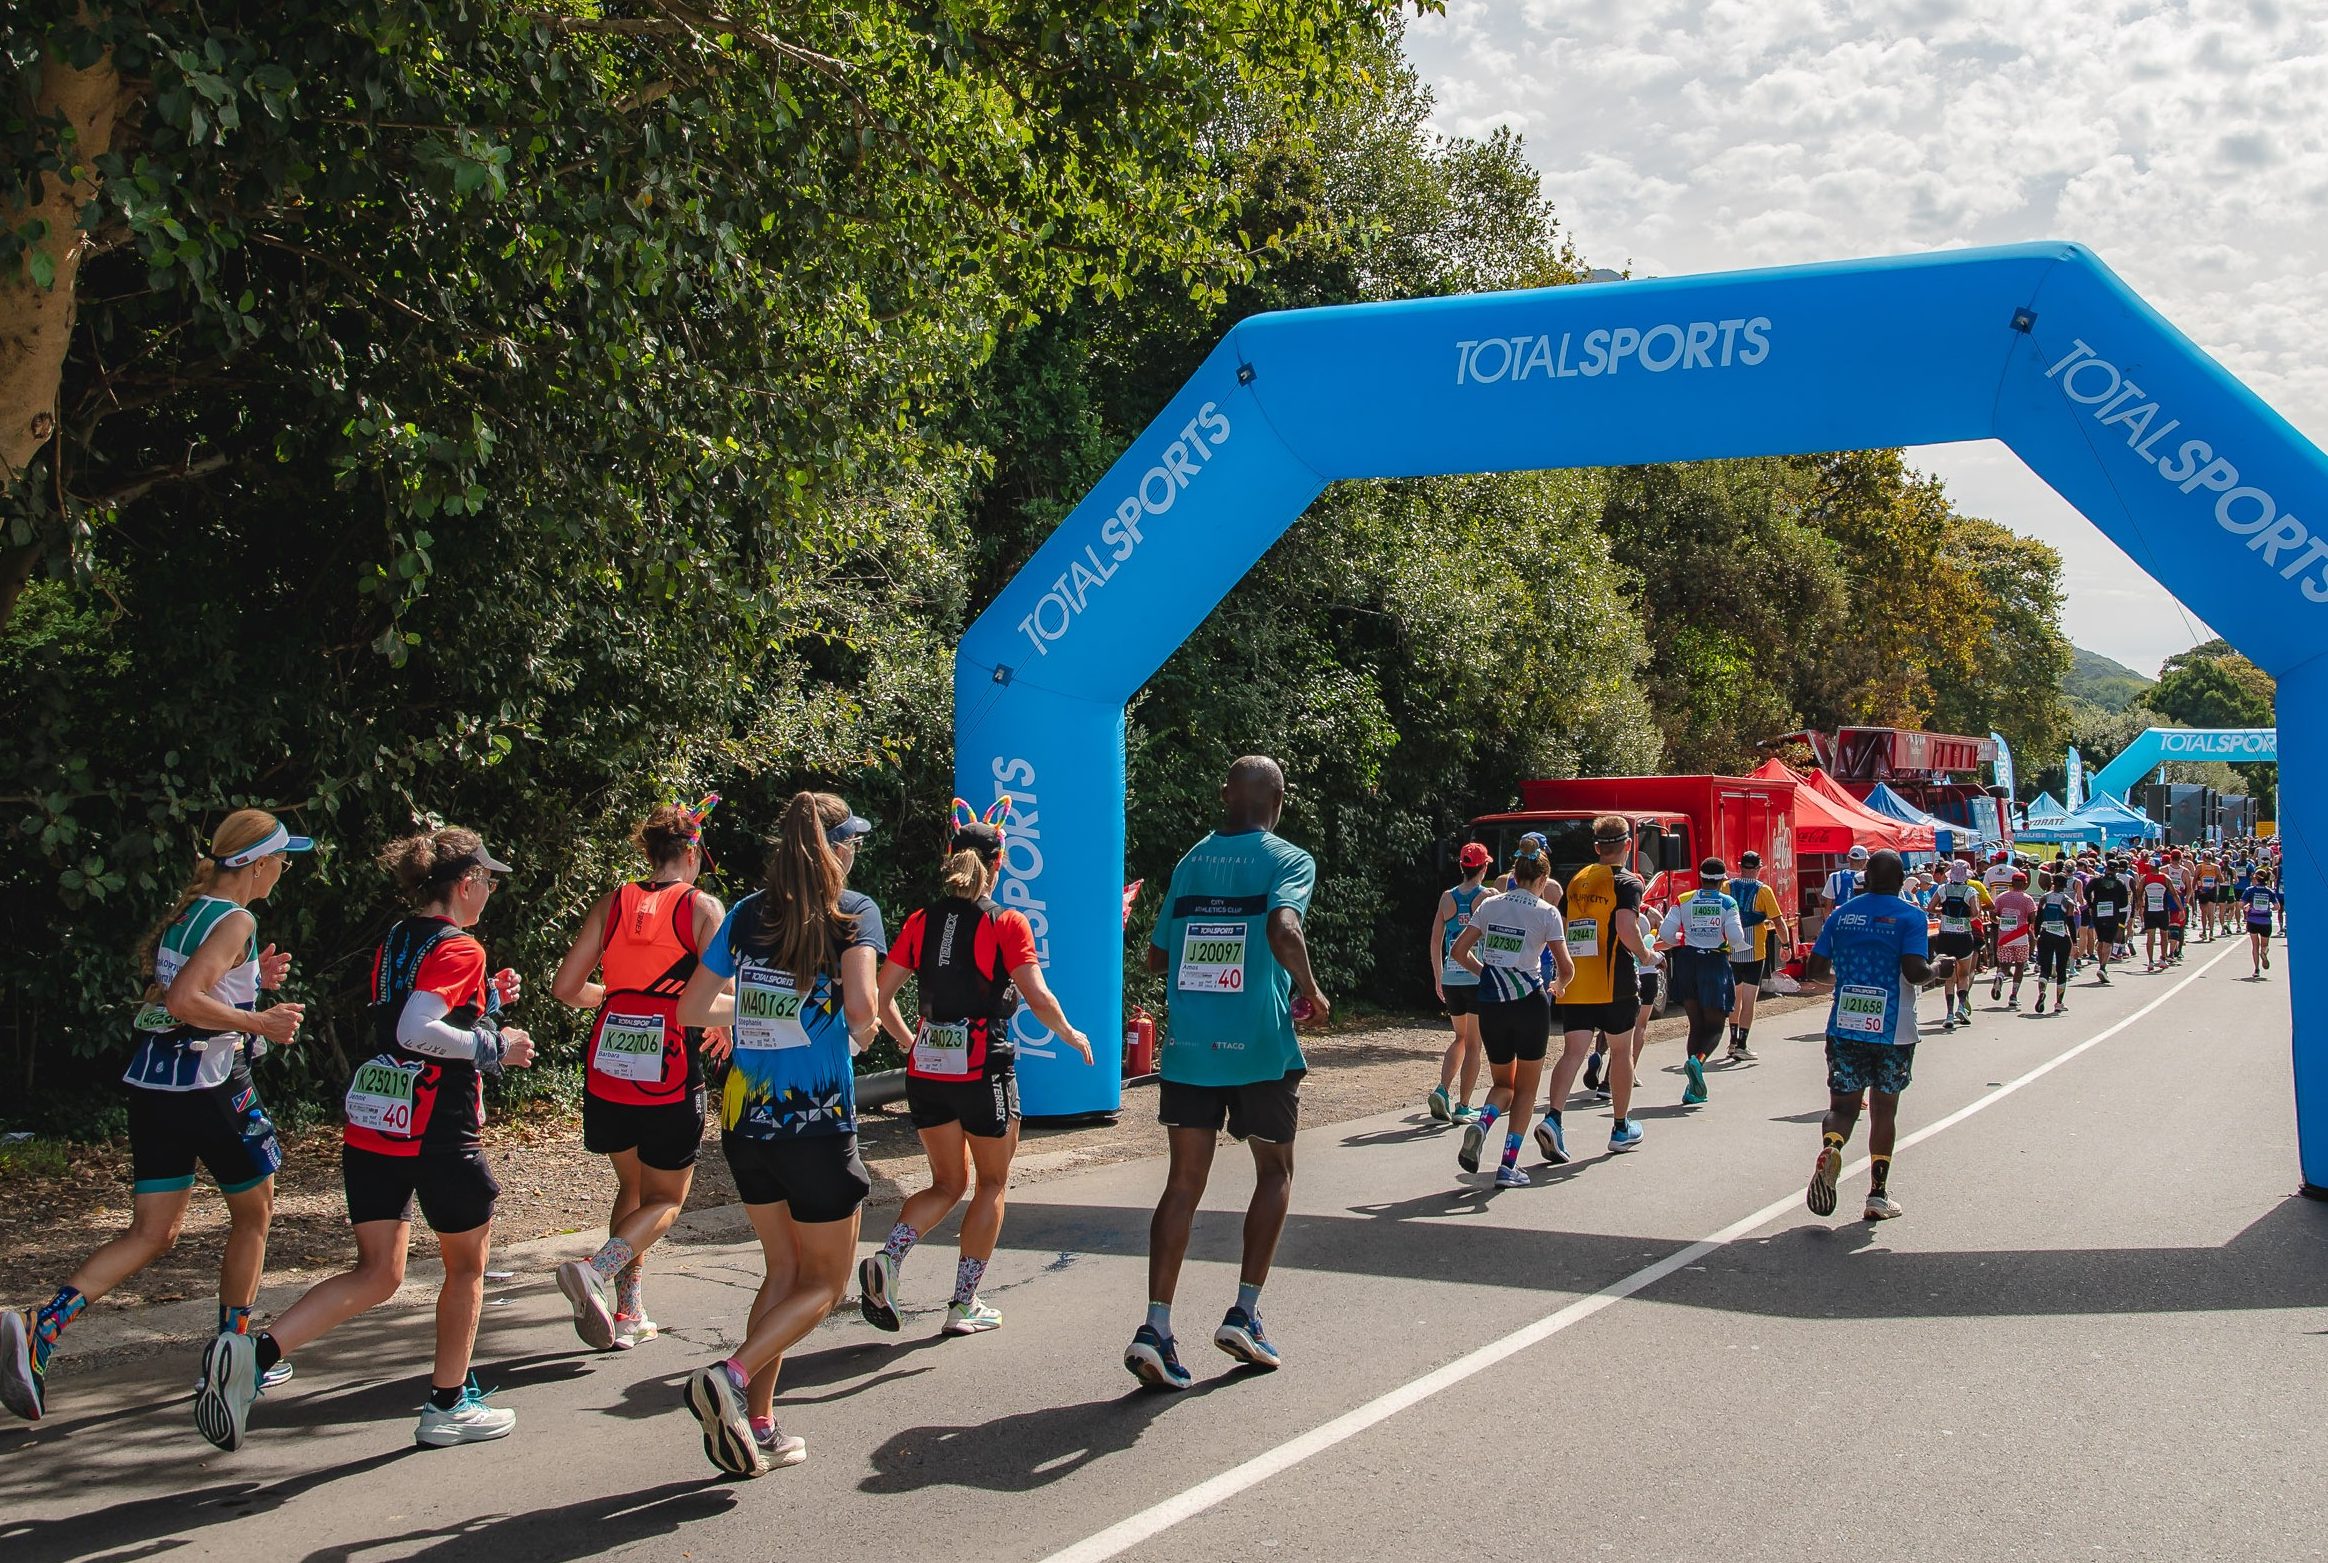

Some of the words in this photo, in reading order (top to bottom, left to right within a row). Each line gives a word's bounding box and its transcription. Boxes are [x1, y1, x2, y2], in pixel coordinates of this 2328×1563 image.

[1456, 316, 1772, 385] TOTALSPORTS
[1017, 401, 1231, 656] TOTALSPORTS
[2160, 734, 2277, 753] TOTALSPOR
[2028, 818, 2066, 827] YDRATE
[1694, 905, 1721, 916] J40598
[1838, 914, 1867, 926] HBIS
[1710, 917, 1721, 927] 40
[938, 912, 958, 967] TERREX
[1488, 936, 1521, 952] J27307
[1189, 943, 1242, 962] J20097
[751, 972, 795, 986] TOTALSPORTS
[1218, 969, 1242, 989] 40
[741, 992, 800, 1017] M40162
[1843, 998, 1883, 1014] J21658
[1864, 1018, 1881, 1031] 50
[605, 1031, 659, 1053] K22706
[598, 1051, 620, 1059] Barbara
[358, 1068, 409, 1096] K25219
[992, 1082, 1006, 1122] TERREX
[382, 1103, 409, 1129] 40
